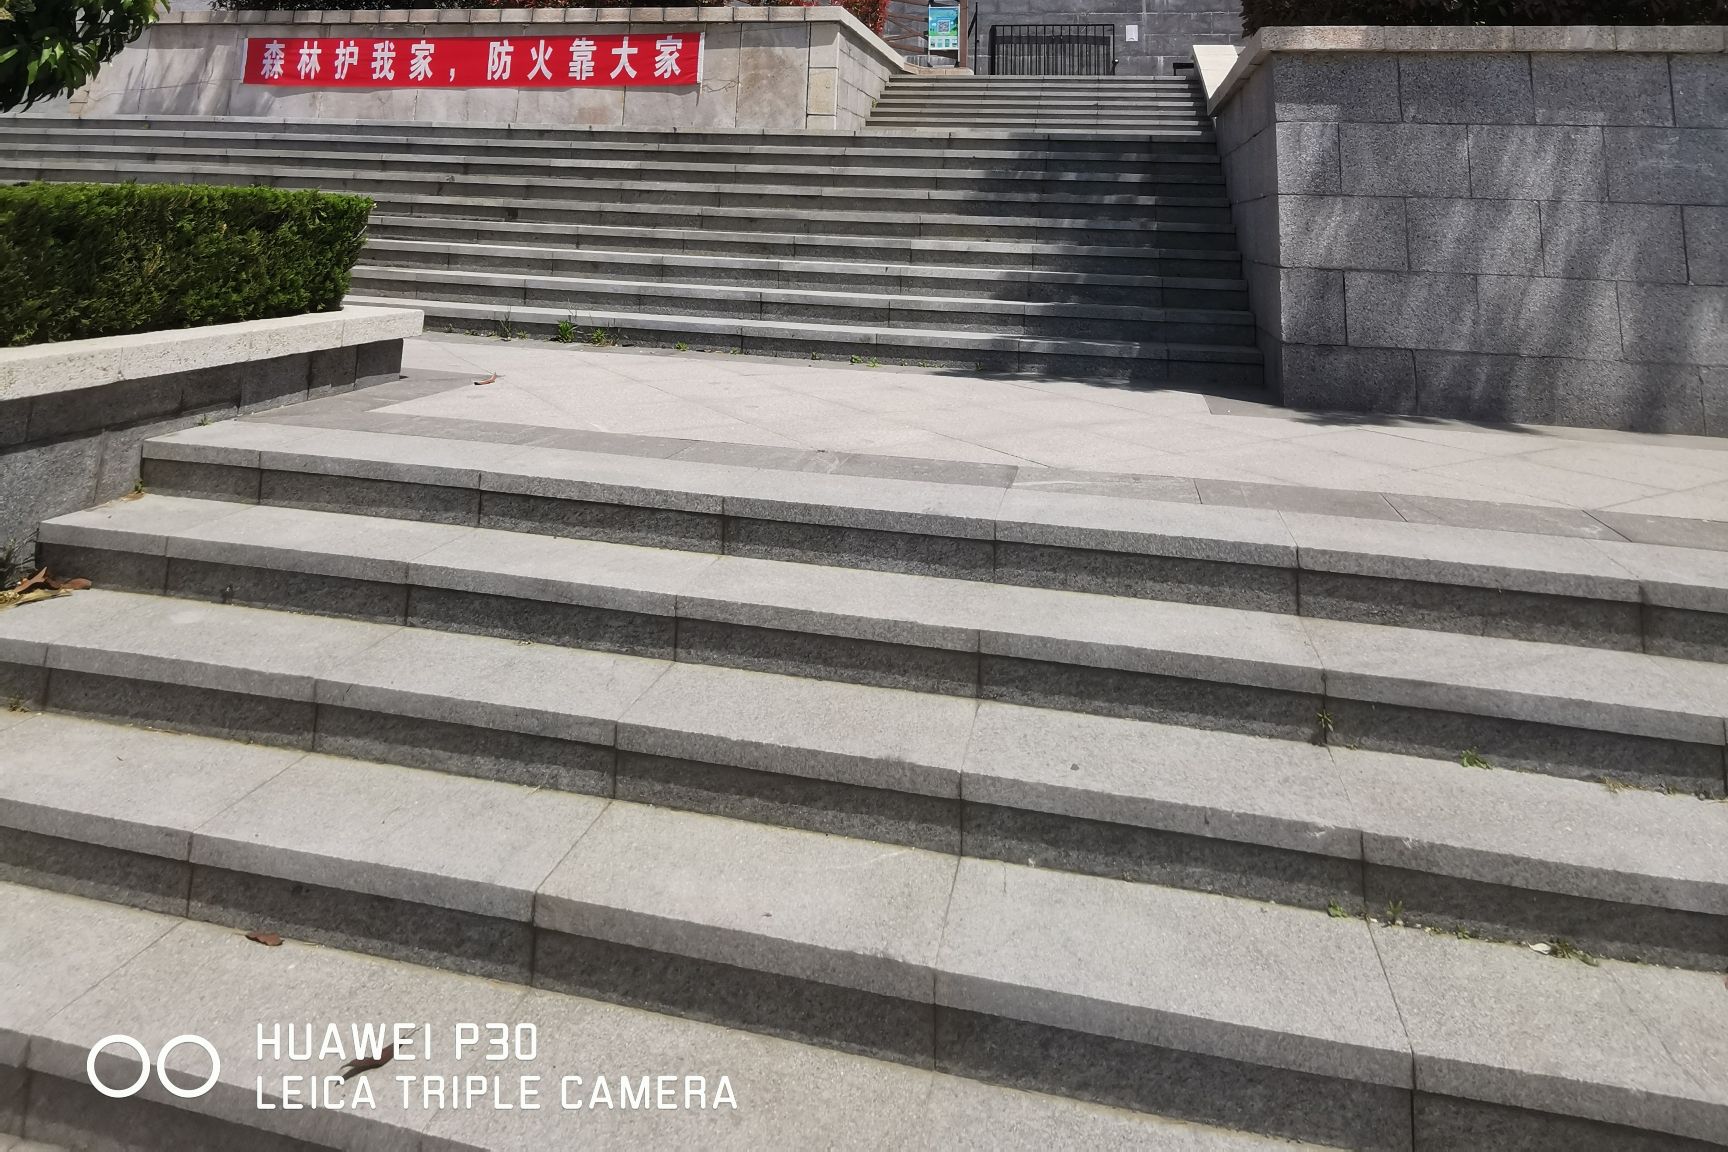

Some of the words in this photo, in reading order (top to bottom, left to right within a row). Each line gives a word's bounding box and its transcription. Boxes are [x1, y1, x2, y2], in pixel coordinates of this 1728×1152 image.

[260, 35, 684, 81] 森林护我家，防火靠大家
